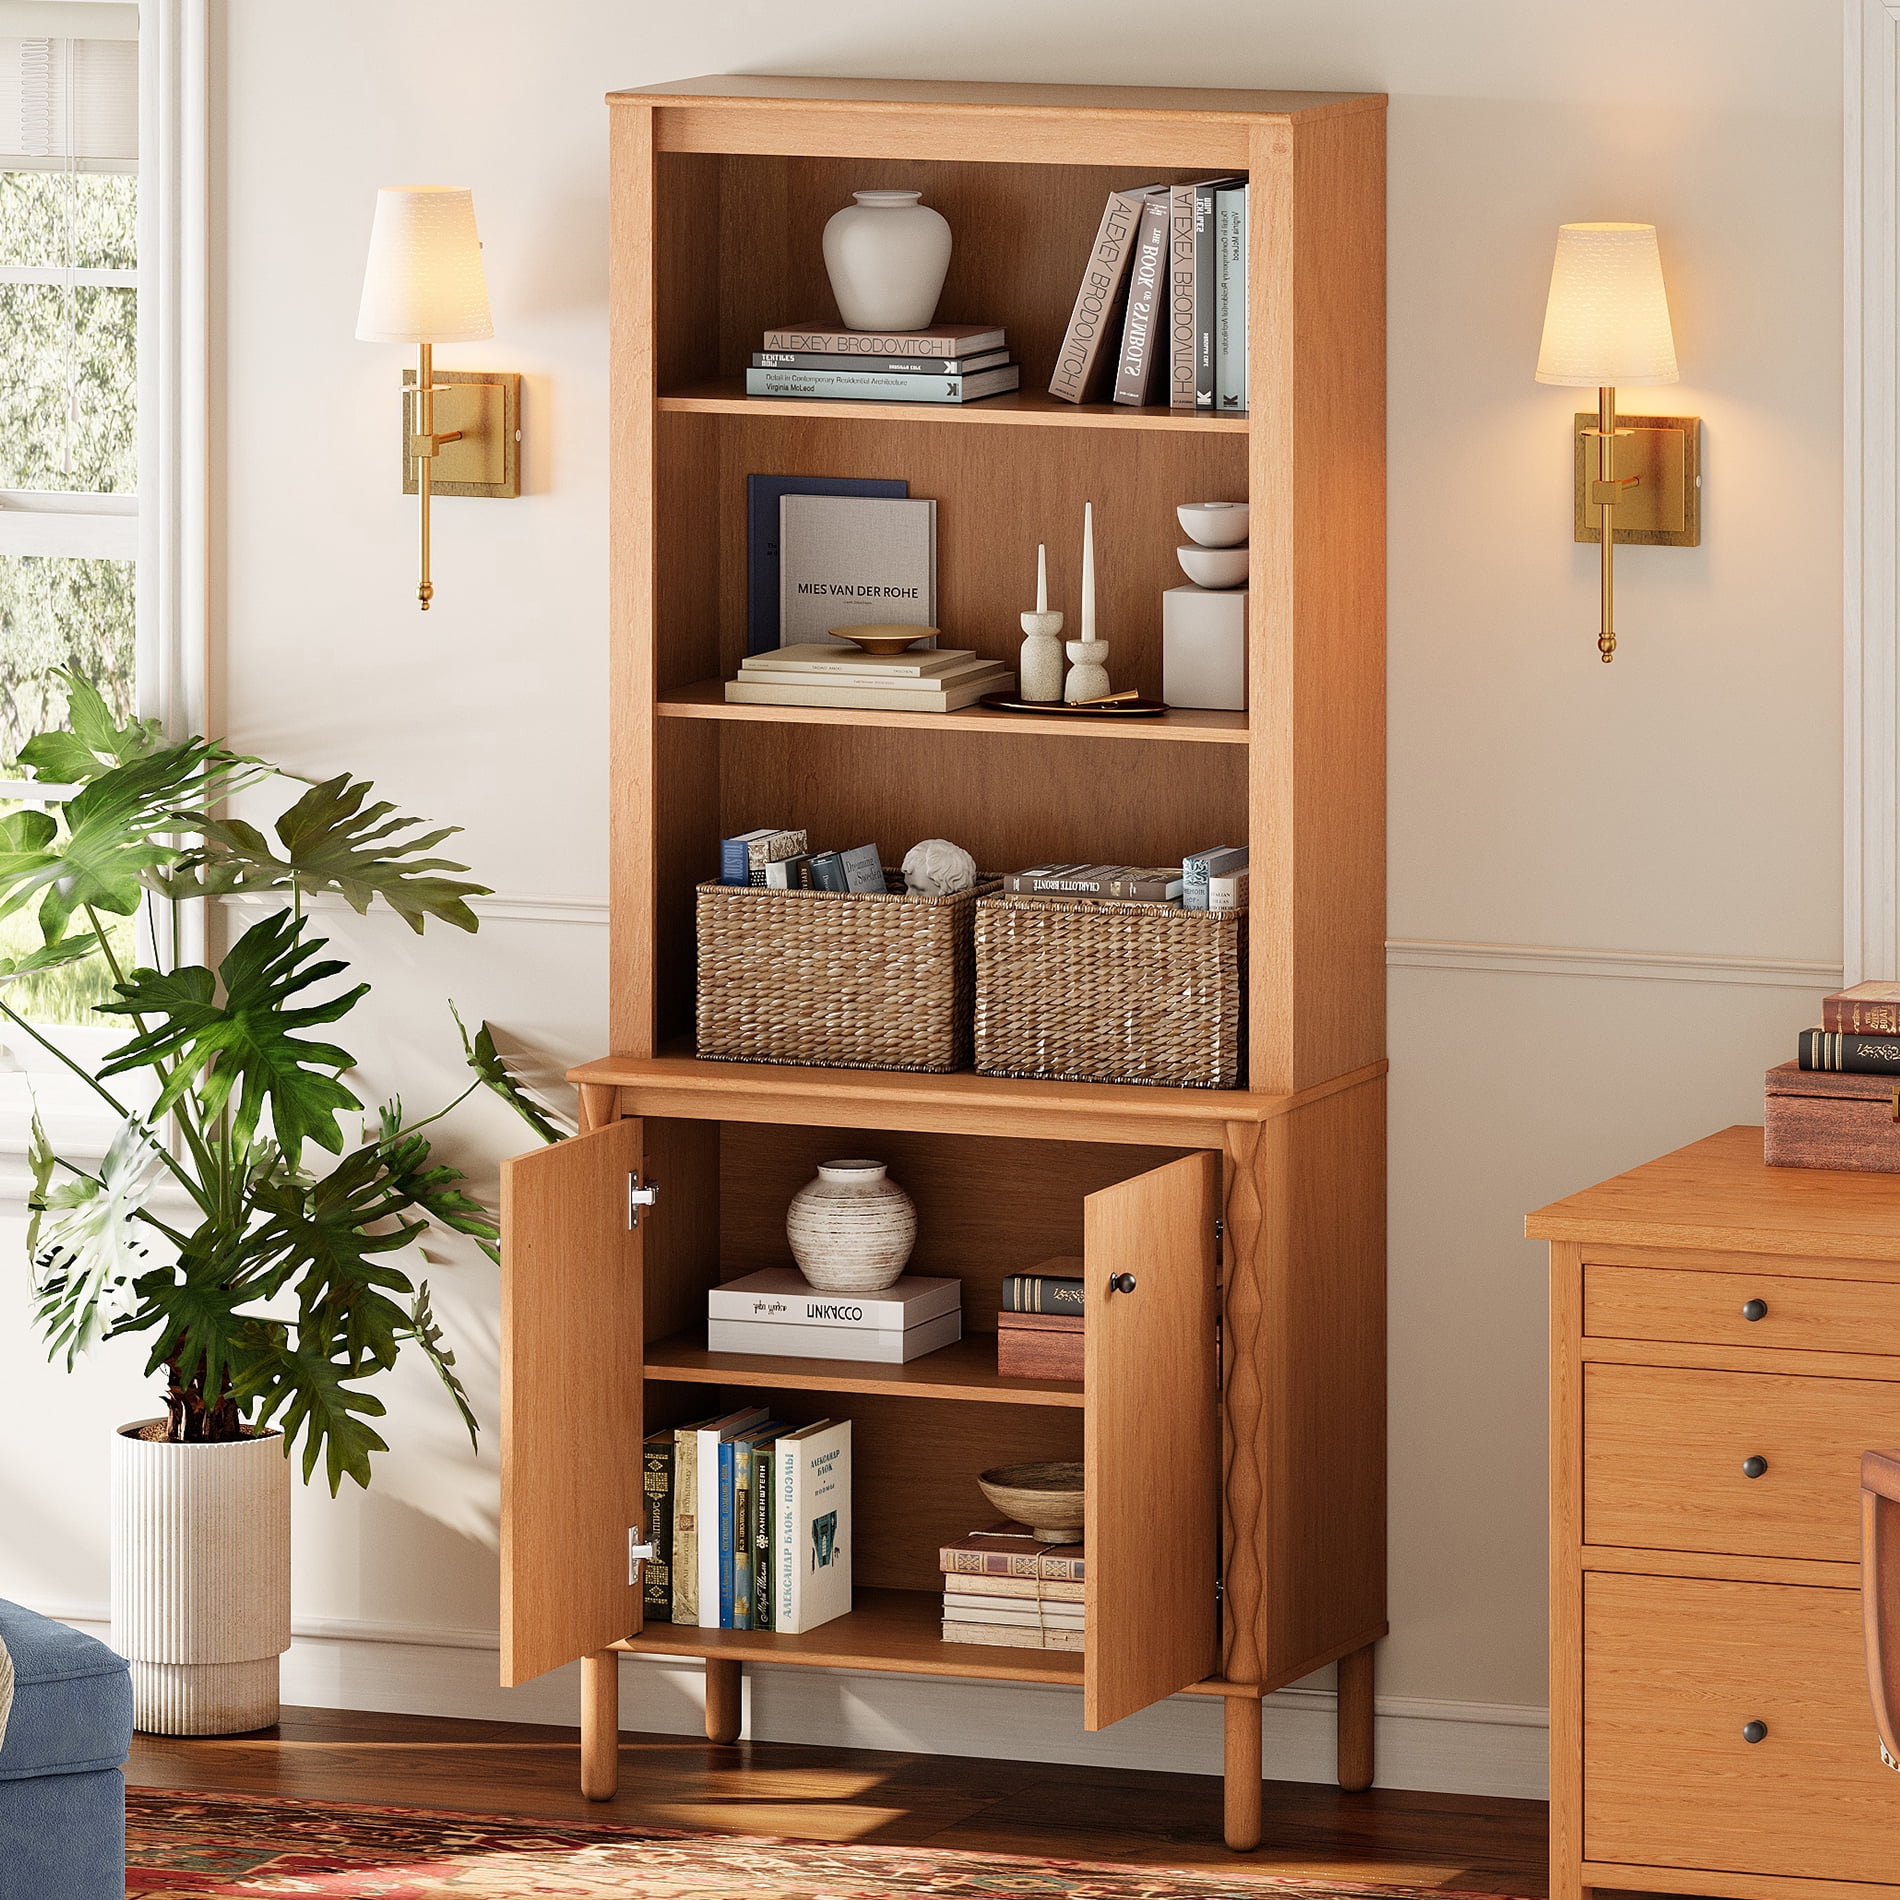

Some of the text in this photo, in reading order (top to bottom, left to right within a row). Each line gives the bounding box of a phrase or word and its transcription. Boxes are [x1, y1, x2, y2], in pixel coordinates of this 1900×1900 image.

[1097, 199, 1132, 273] ALEXEY
[1059, 271, 1111, 389] BRODOVITCH
[768, 334, 943, 355] ALEXEY BRODOVITCH
[766, 383, 815, 392] Virginia McLeod
[798, 583, 919, 598] MIES VAN DER ROHE
[724, 844, 743, 880] TOLSTOY
[1060, 880, 1100, 892] CHARLOTTE
[782, 1454, 794, 1619] АЛЕКСАНДР БЛОК ПОЭМЫ
